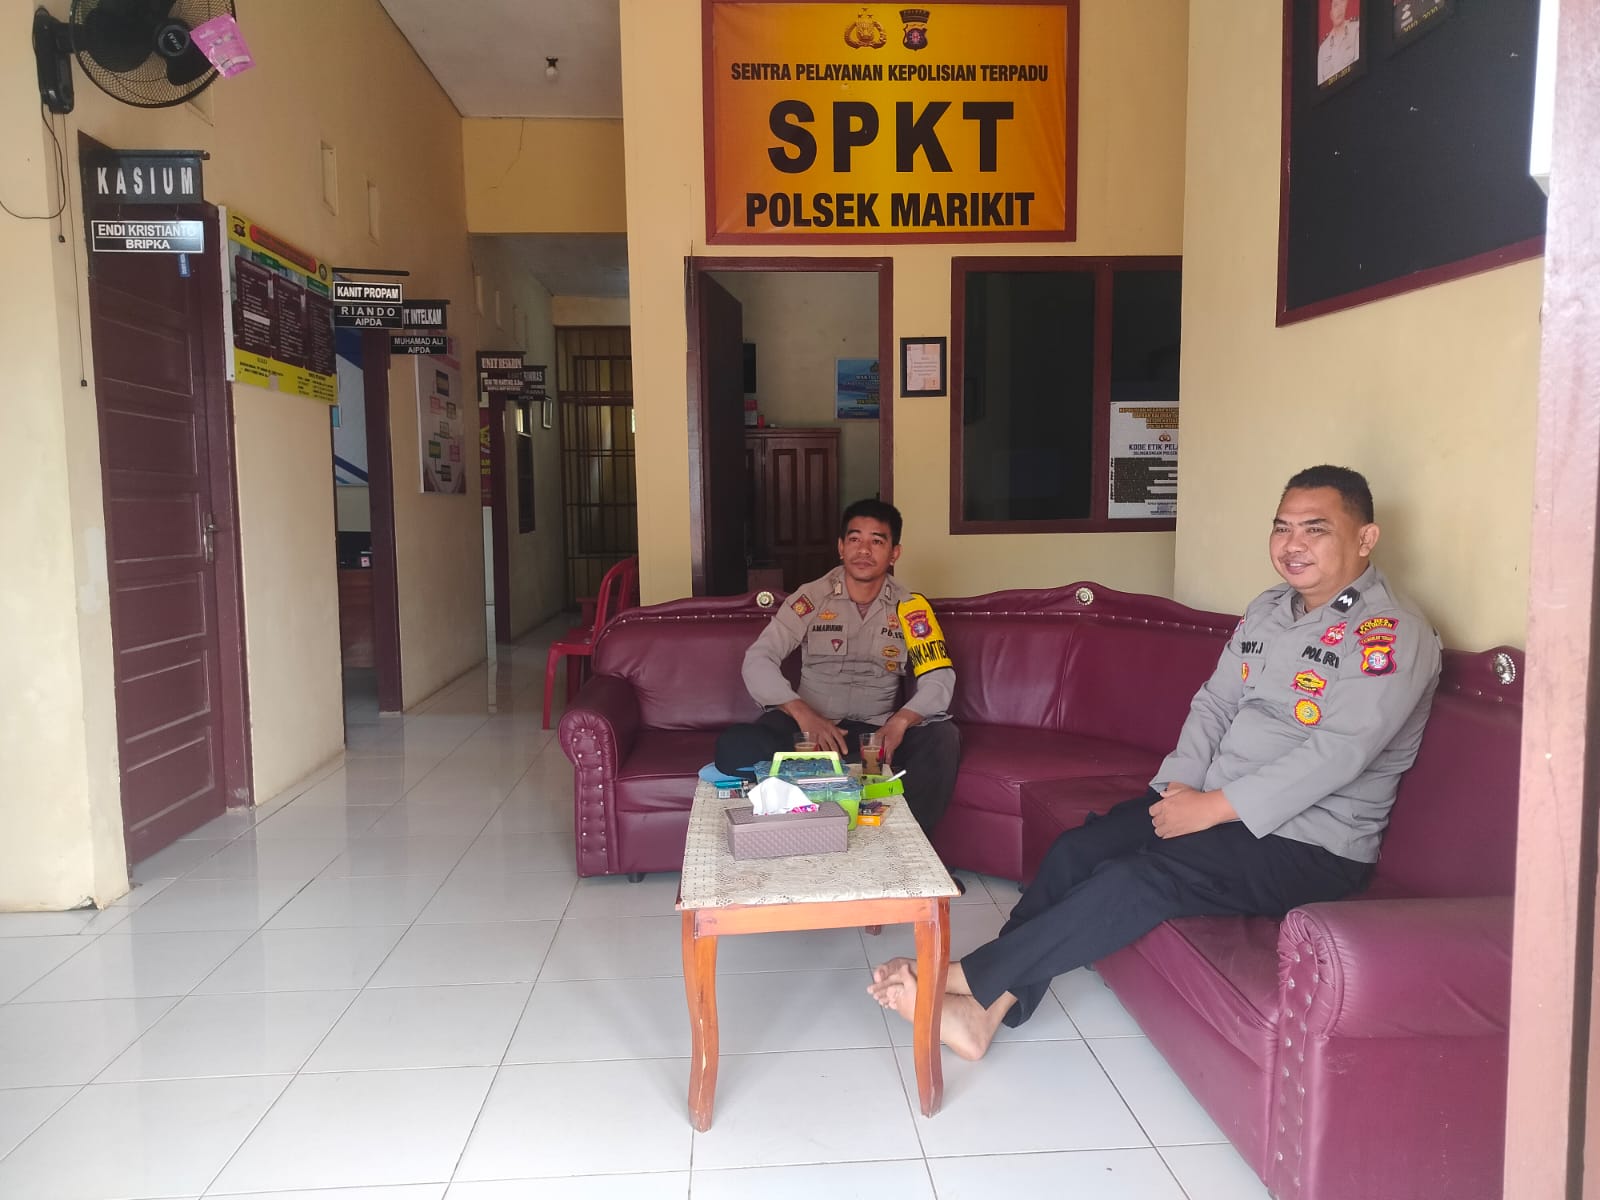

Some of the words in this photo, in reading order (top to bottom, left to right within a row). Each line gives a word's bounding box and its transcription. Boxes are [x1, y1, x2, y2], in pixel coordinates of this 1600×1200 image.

[731, 62, 792, 81] SENTRA
[795, 63, 883, 81] PELAYANAN
[888, 64, 976, 82] KEPOLISIAN
[980, 64, 1048, 82] TERPADU
[767, 99, 1014, 174] SPKT
[97, 166, 194, 195] KASIUM
[746, 192, 880, 228] POLSEK
[890, 191, 1035, 227] MARIKIT
[98, 224, 126, 236] ENDI
[128, 224, 196, 237] KRISTIANTO
[125, 239, 171, 250] BRIPKA
[337, 286, 363, 298] KANIT
[364, 287, 399, 299] PROPAM
[341, 306, 396, 317] RIANDO
[355, 318, 382, 327] AIPDA
[394, 337, 431, 345] MUHAMAD
[432, 337, 444, 345] ALI
[408, 346, 431, 354] AIPDA
[1128, 443, 1146, 451] KODE
[1147, 443, 1162, 451] ETIK
[1301, 645, 1340, 669] POLRI
